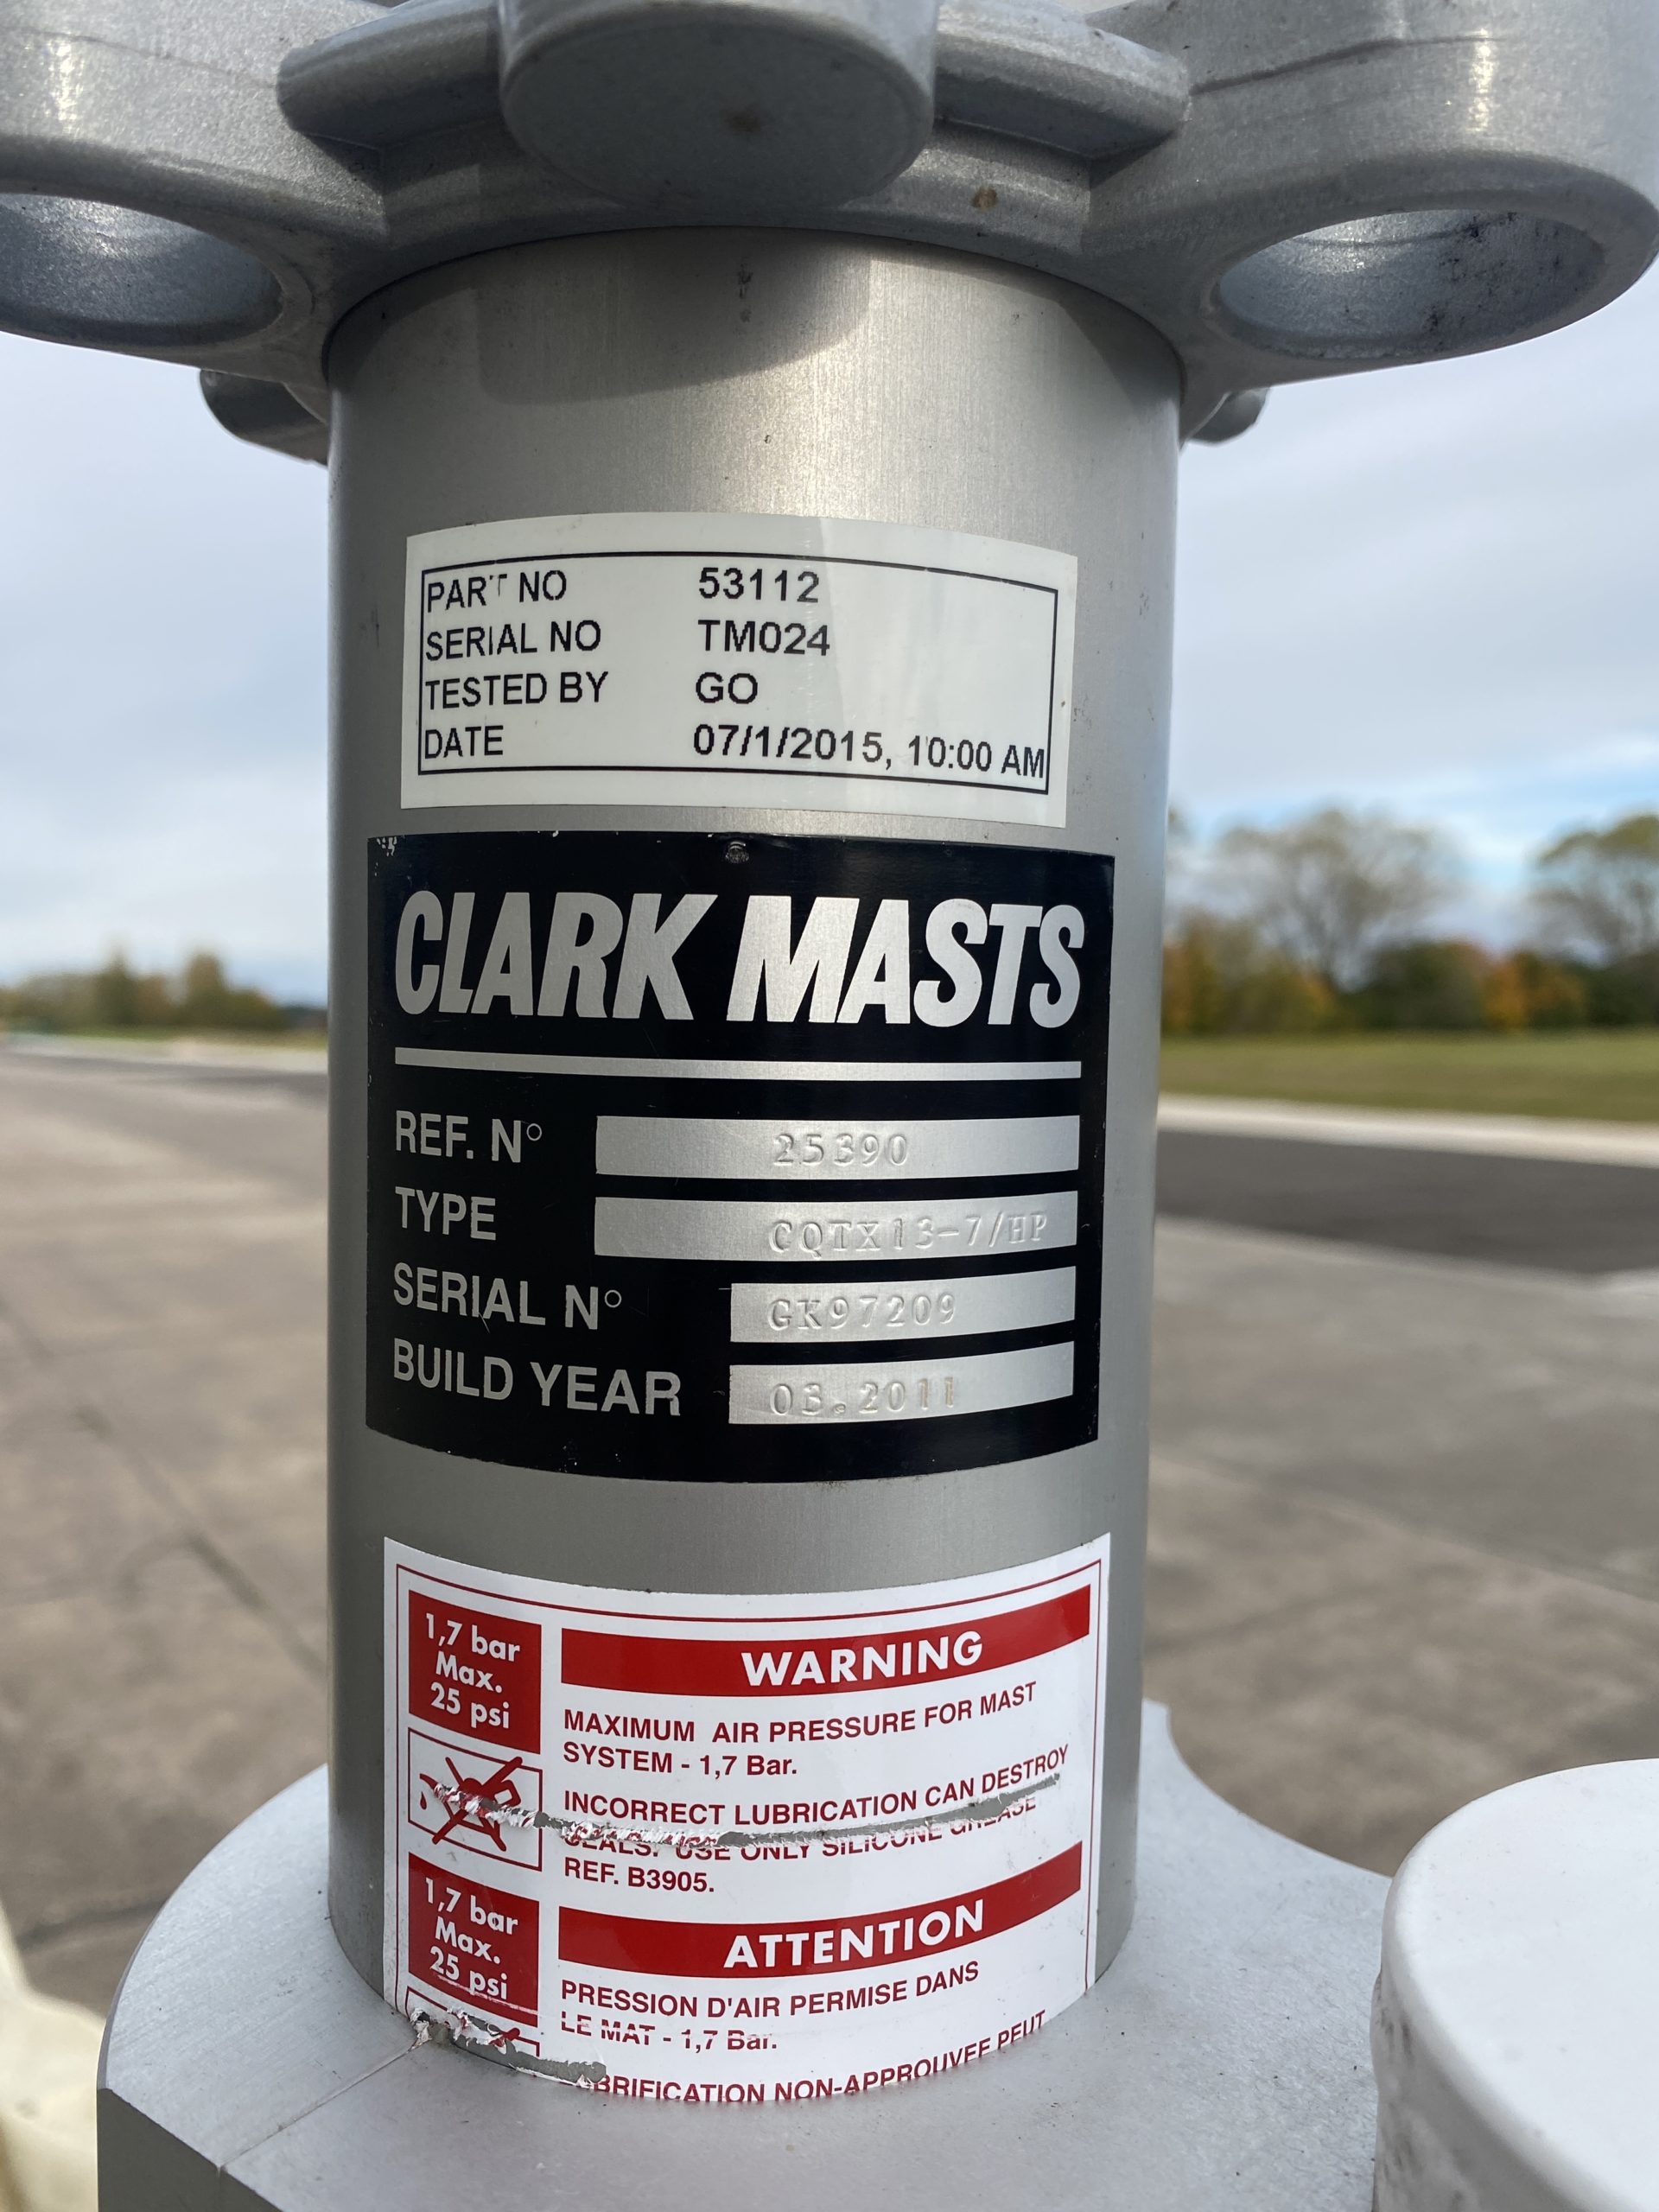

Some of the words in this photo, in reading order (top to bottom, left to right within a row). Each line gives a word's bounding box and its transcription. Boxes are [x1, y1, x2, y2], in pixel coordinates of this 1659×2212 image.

[427, 574, 508, 613] PART
[518, 569, 568, 603] NO
[698, 567, 820, 603] 53112
[425, 622, 538, 662] SERIAL
[550, 620, 601, 652] NO
[697, 619, 830, 657] TM024
[424, 673, 548, 710] TESTED
[560, 671, 609, 703] BY
[695, 671, 759, 705] GO
[424, 725, 504, 760] DATE
[693, 723, 893, 772] 07/1/2015,
[907, 734, 993, 772] 10:00
[1000, 744, 1046, 779] AM
[394, 890, 719, 1021] CLARK
[725, 894, 1084, 1030] MASTS
[395, 1109, 474, 1160] REF.
[772, 1132, 909, 1166] 25390
[394, 1185, 497, 1241] TYPE
[768, 1210, 1049, 1260] CQTX13-7/HP
[392, 1262, 547, 1326] SERIAL
[767, 1293, 957, 1332] GK97209
[393, 1337, 514, 1402] BUILD
[529, 1361, 682, 1417] YEAR
[425, 1612, 463, 1647] 1,7
[471, 1624, 521, 1662] bar
[741, 1630, 983, 1687] WARNING
[435, 1650, 503, 1694] Max.
[430, 1681, 461, 1715] 25
[470, 1701, 510, 1729] psi
[563, 1708, 695, 1743] MAXIMUM
[711, 1722, 759, 1744] AIR
[769, 1709, 916, 1743] PRESSURE
[924, 1700, 973, 1728] FOR
[979, 1680, 1037, 1716] MAST
[563, 1741, 673, 1773] SYSTEM
[699, 1754, 738, 1779] 1,7
[746, 1755, 798, 1776] Bar.
[563, 1789, 726, 1825] INCORRECT
[734, 1789, 917, 1826] LUBRICATION
[925, 1777, 975, 1808] CAN
[981, 1743, 1069, 1794] DESTROY
[564, 1856, 619, 1885] REF.
[627, 1866, 715, 1893] B3905.
[424, 1877, 462, 1913] 1,7
[469, 1894, 518, 1936] bar
[434, 1916, 501, 1965] Max.
[723, 1898, 984, 1969] ATTENTION
[429, 1945, 461, 1981] 25
[469, 1972, 508, 2000] psi
[561, 1980, 698, 2018] PRESSION
[707, 1996, 780, 2018] D'AIR
[790, 1980, 908, 2016] PERMISE
[916, 1961, 980, 1997] DANS
[561, 2011, 593, 2037] LE
[601, 2018, 657, 2046] MAT
[681, 2028, 719, 2054] 1,7
[727, 2030, 778, 2050] Bar.
